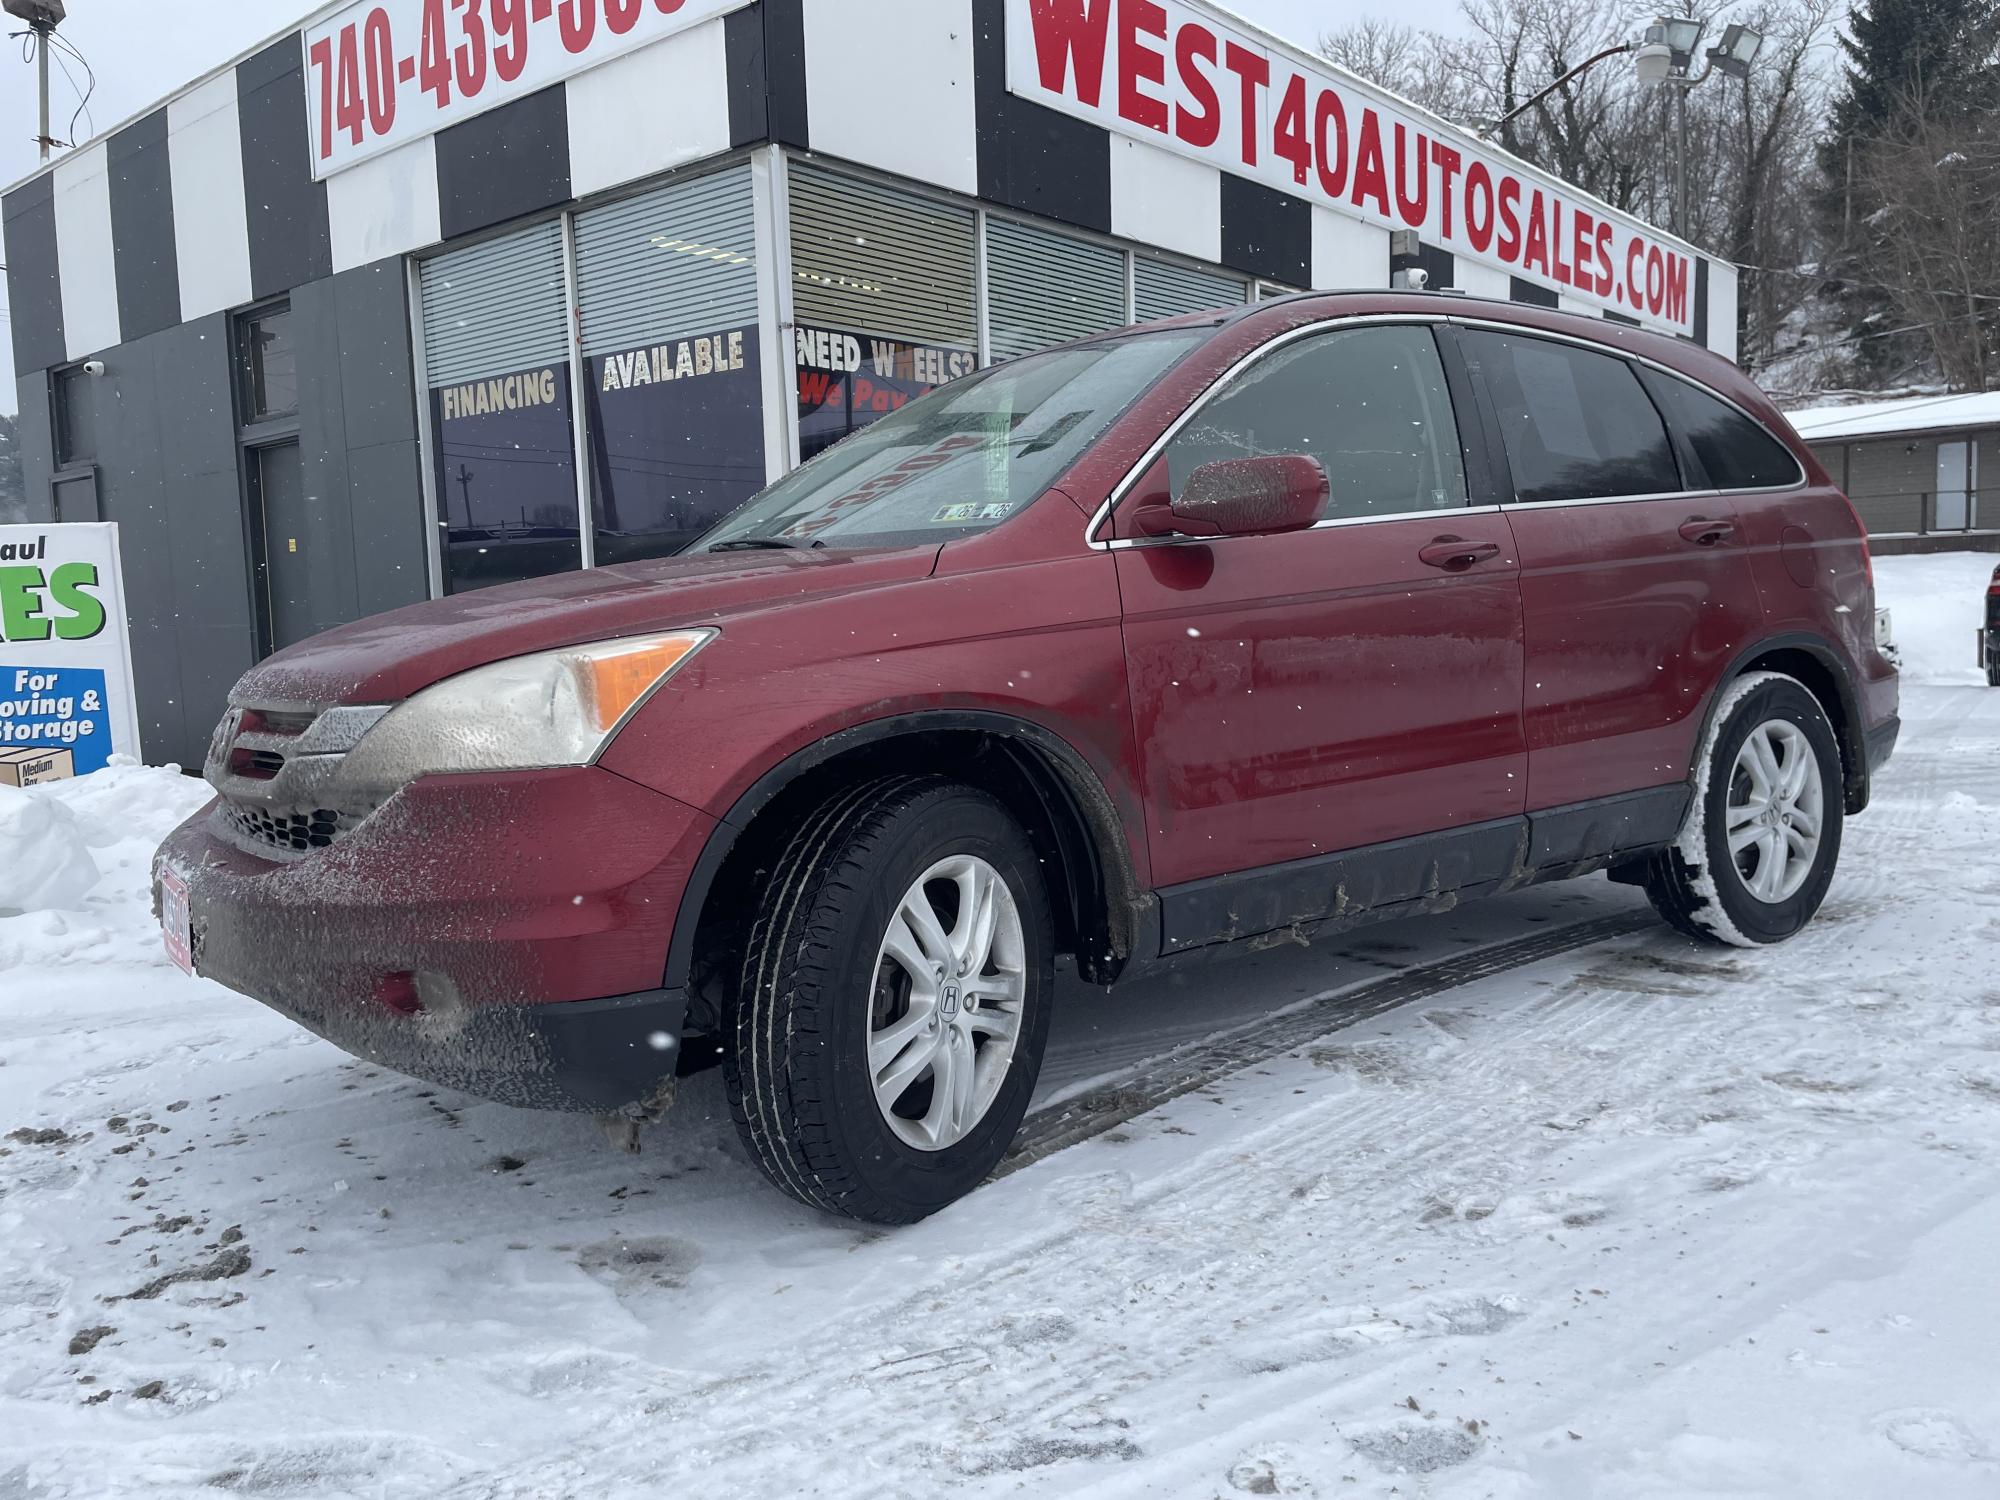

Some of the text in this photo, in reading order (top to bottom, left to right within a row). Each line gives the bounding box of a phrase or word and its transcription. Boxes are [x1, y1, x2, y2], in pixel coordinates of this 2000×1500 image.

[310, 0, 688, 160] 740-439-
[1026, 0, 1690, 326] WEST40AUTOSALES.COM
[602, 330, 744, 392] AVAILABLE
[795, 327, 975, 386] NEED WHEELS?
[442, 368, 556, 421] FINANCING
[800, 371, 843, 407] We
[0, 536, 46, 560] aul
[0, 562, 107, 642] ES
[15, 670, 58, 692] For
[0, 689, 101, 720] oving &
[0, 719, 95, 743] torage
[22, 760, 53, 778] Medium
